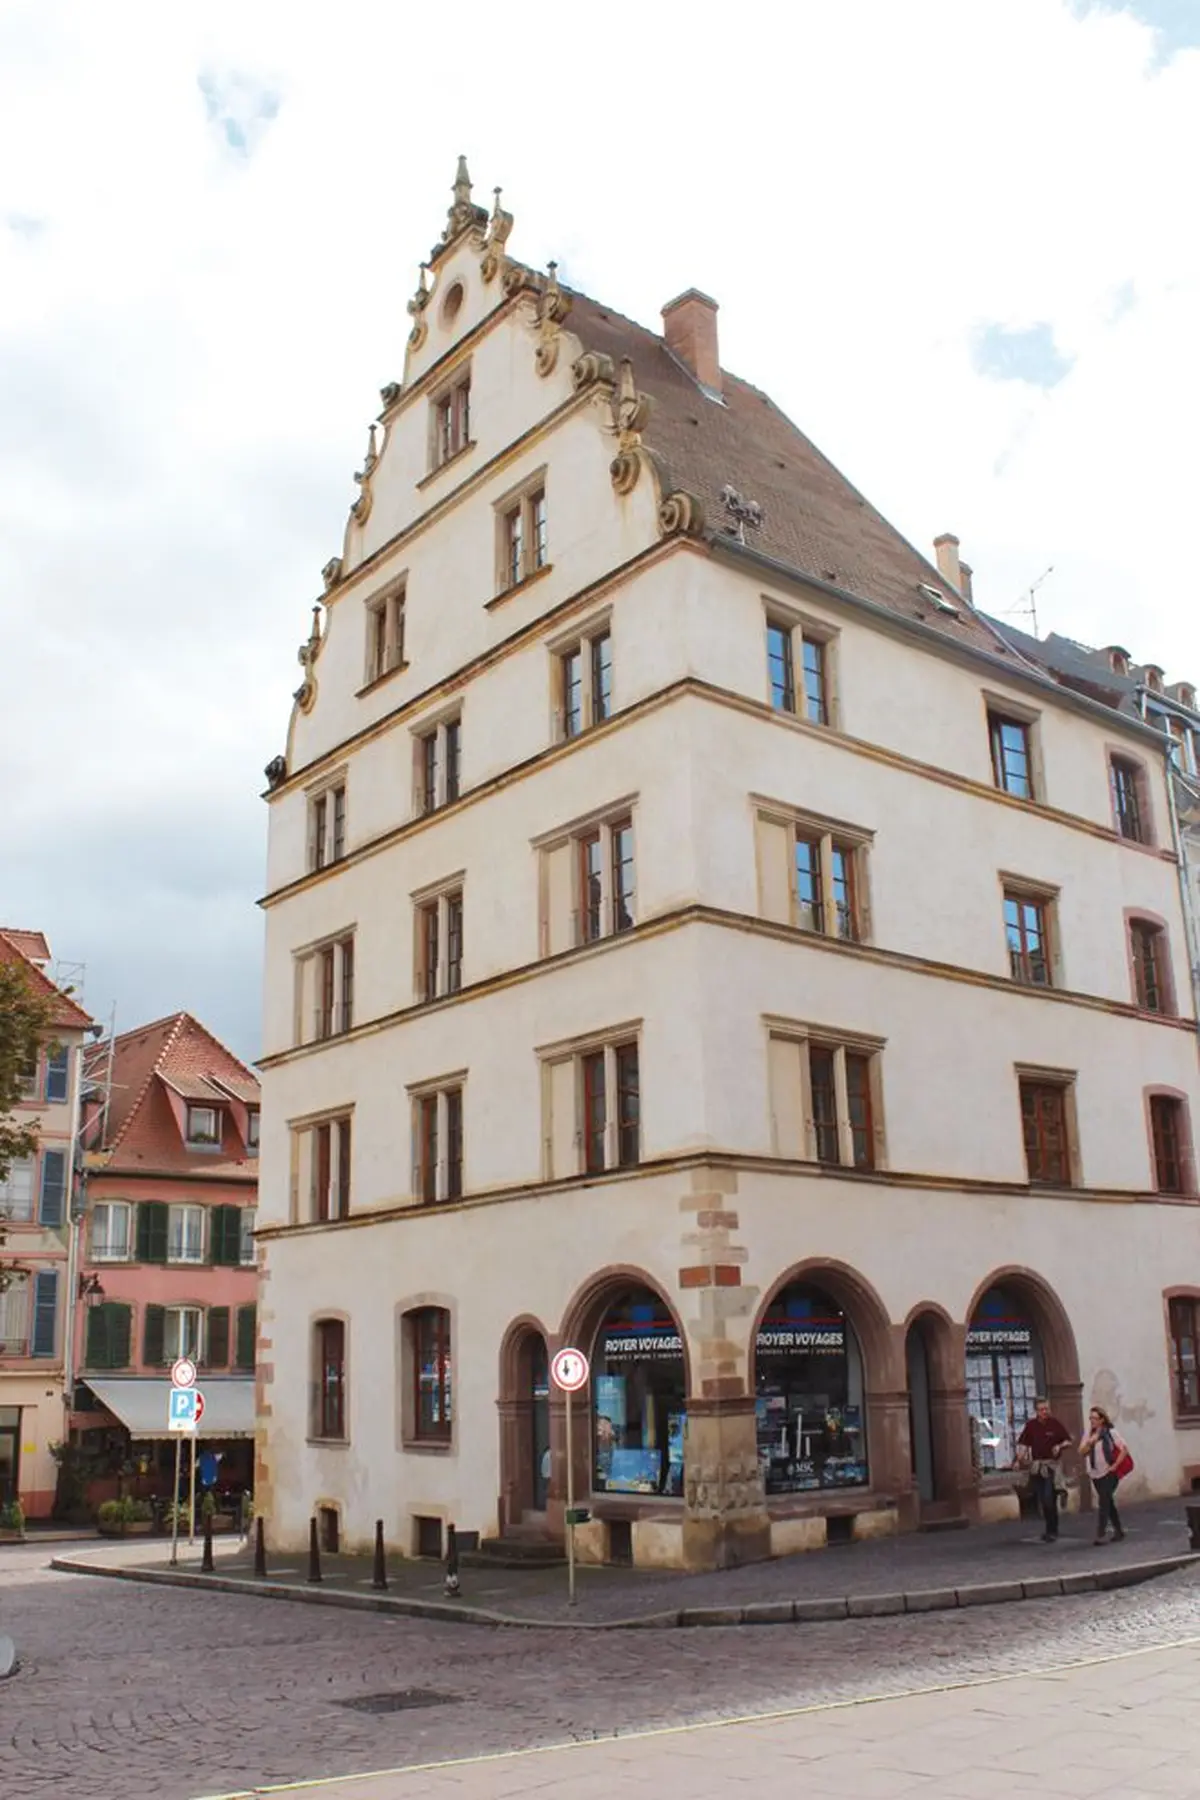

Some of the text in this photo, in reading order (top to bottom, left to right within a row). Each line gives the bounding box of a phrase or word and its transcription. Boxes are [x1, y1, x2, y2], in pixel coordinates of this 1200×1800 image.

[756, 1332, 843, 1345] ROYER VOYAGES
[966, 1331, 1030, 1343] OYER VOYAGES
[605, 1339, 637, 1351] ROYER
[177, 1395, 189, 1416] P
